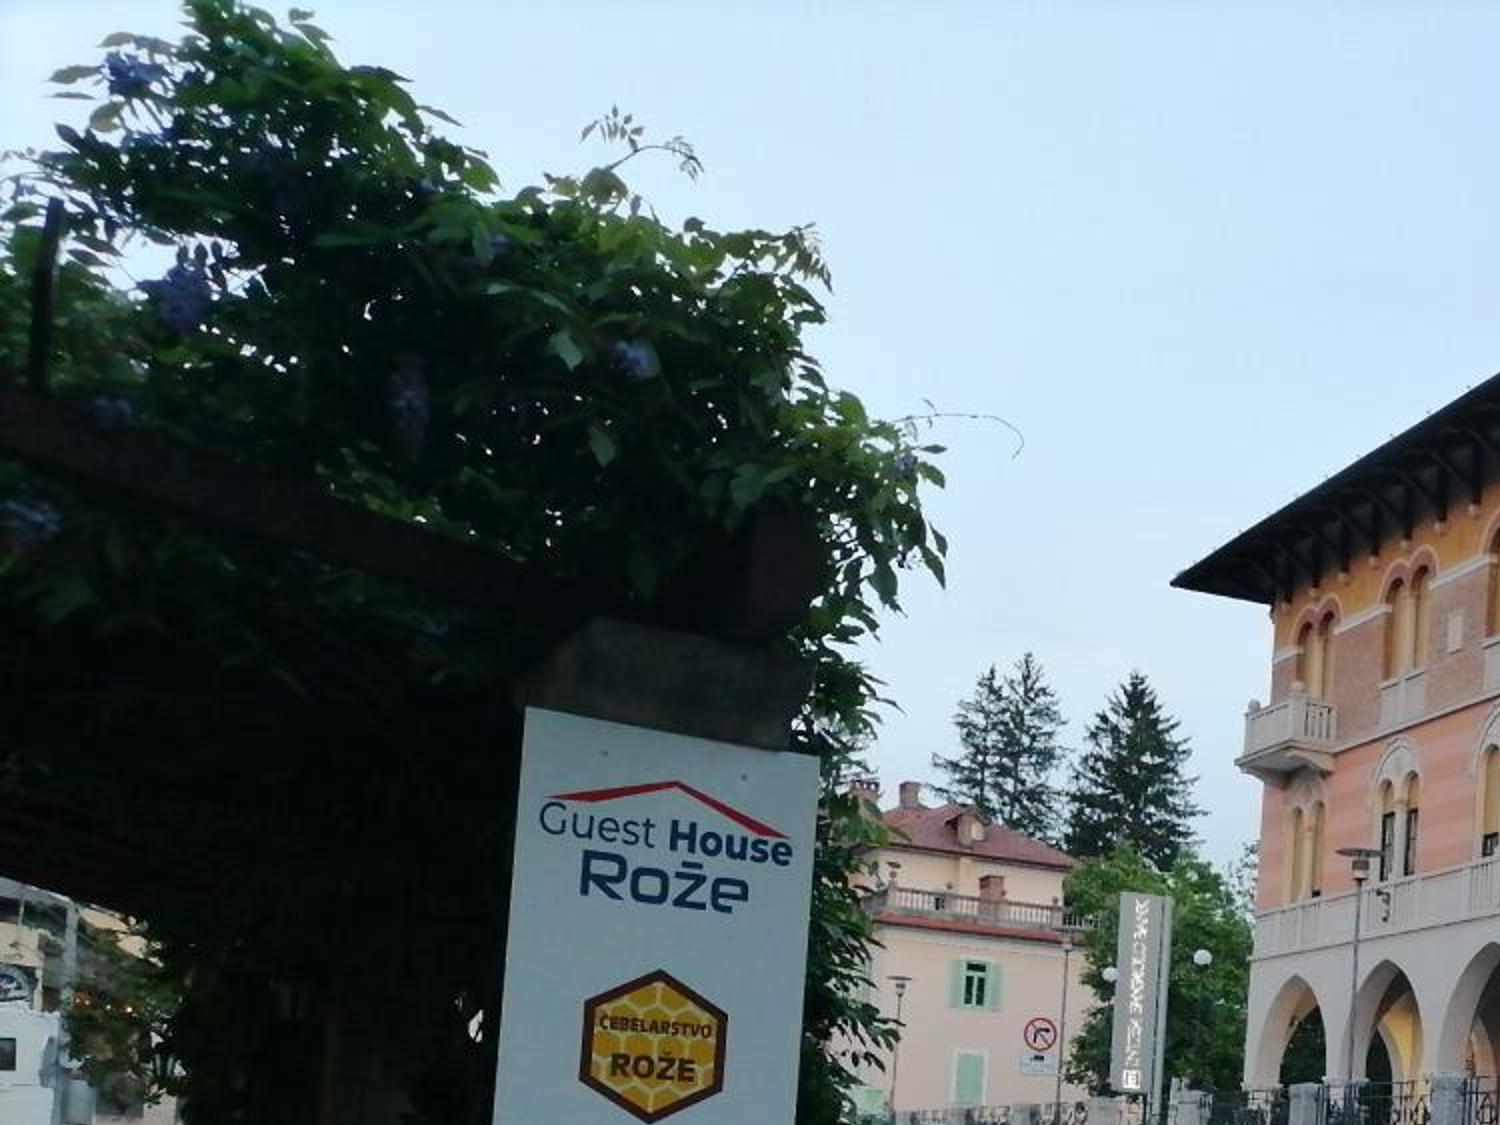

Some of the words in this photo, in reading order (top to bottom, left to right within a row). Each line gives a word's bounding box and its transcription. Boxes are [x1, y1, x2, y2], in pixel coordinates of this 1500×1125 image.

[539, 801, 656, 849] Guest
[669, 818, 793, 867] House
[579, 849, 749, 914] Rože
[610, 1049, 697, 1083] ROŽE
